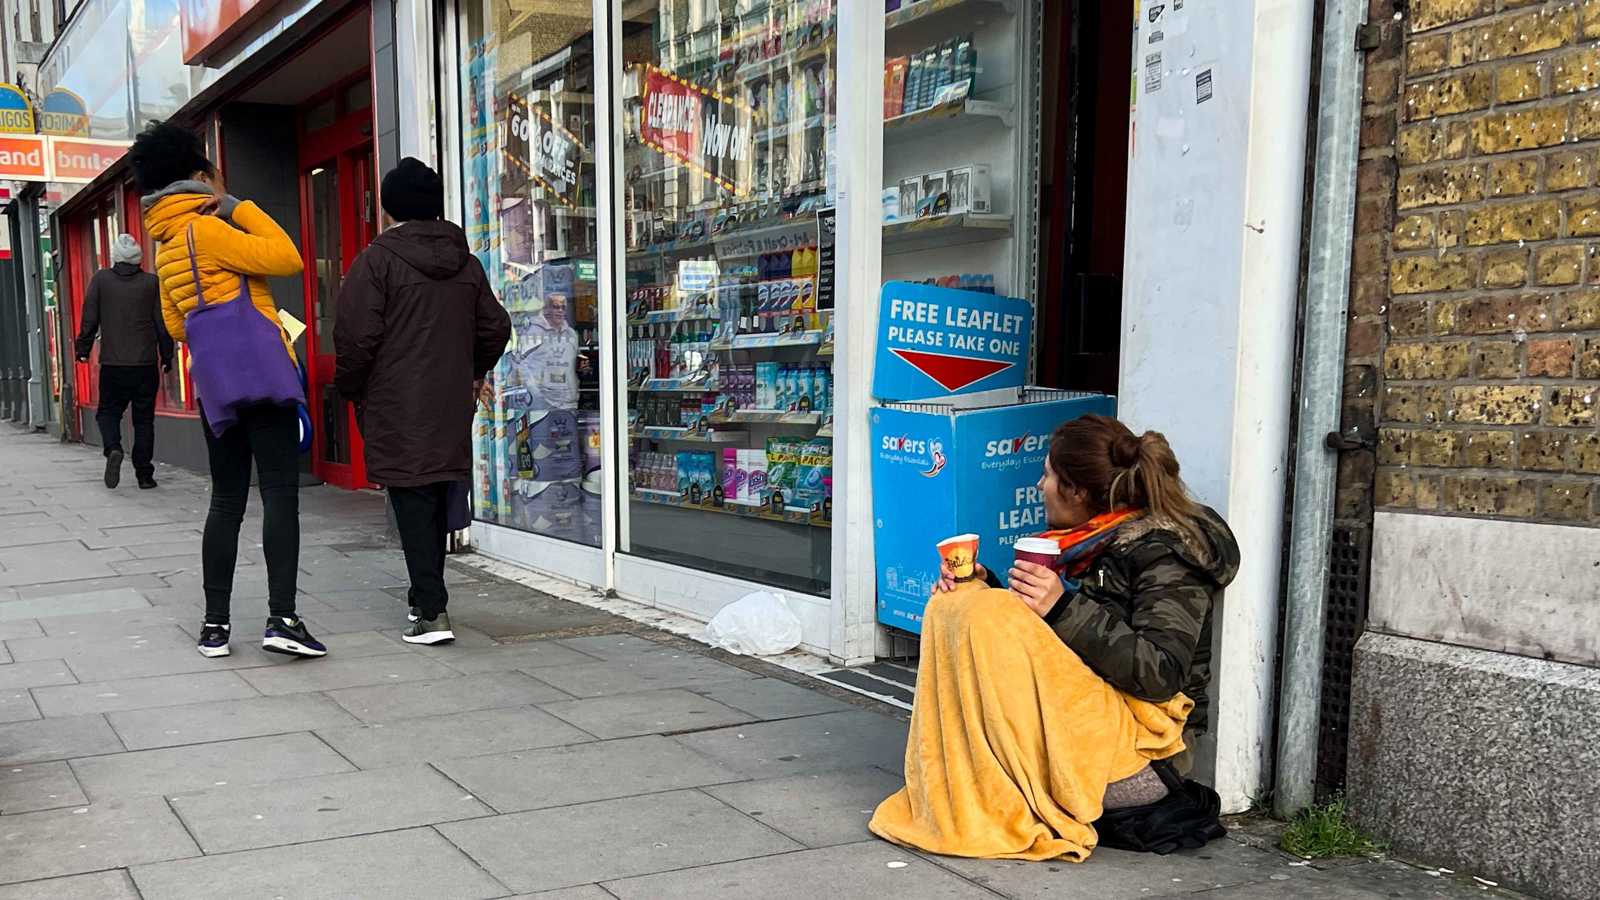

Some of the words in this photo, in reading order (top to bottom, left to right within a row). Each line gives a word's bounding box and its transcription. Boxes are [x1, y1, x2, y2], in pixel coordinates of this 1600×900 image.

[0, 111, 31, 128] IGOS
[890, 299, 939, 324] FREE
[945, 306, 1024, 335] LEAFLET
[888, 326, 943, 346] PLEASE
[948, 332, 985, 352] TAKE
[989, 339, 1020, 356] ONE
[882, 433, 926, 455] savers
[984, 432, 1050, 457] saver
[1015, 486, 1046, 506] FRE
[999, 506, 1045, 530] LEAF
[998, 532, 1032, 546] PLEA
